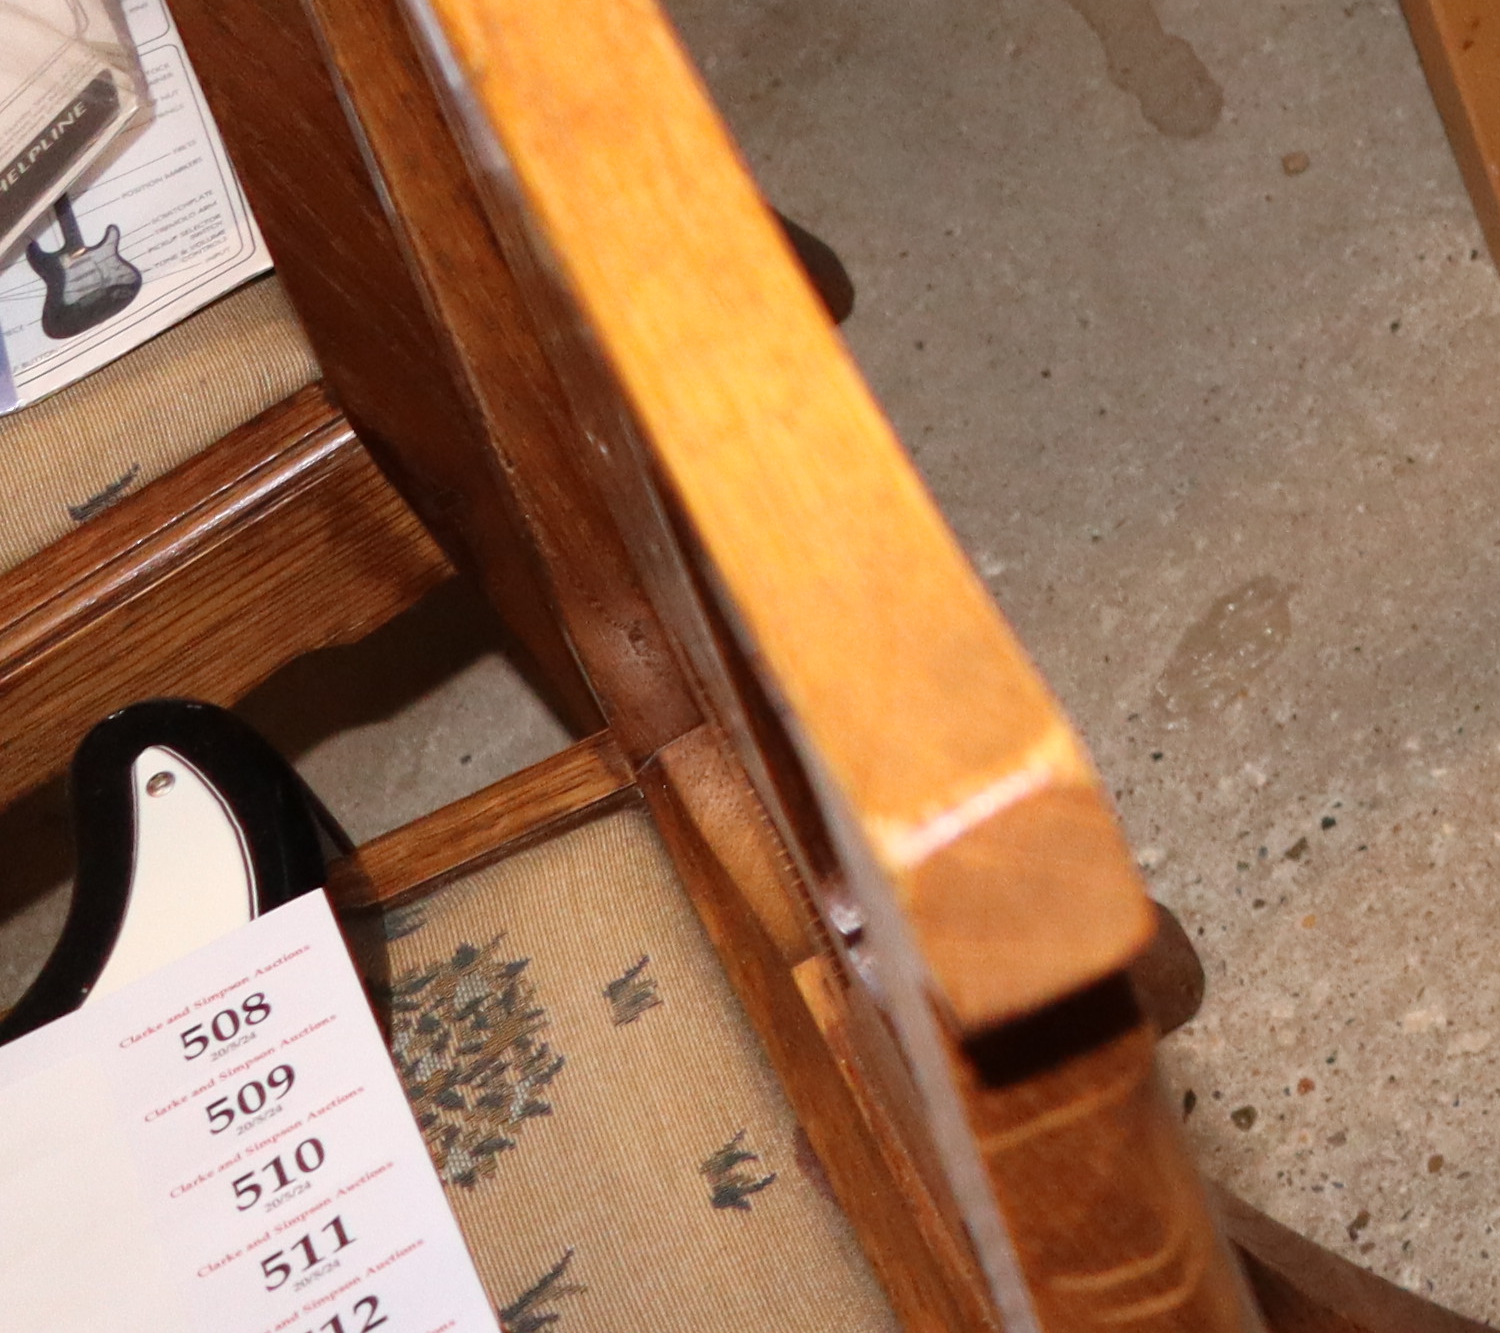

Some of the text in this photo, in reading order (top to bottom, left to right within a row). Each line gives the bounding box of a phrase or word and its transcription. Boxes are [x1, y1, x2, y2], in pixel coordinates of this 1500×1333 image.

[119, 944, 311, 1049] Clarke and Simpson Auctions
[180, 992, 272, 1061] 508
[144, 1014, 337, 1123] Clarke and Simpson Auctions
[205, 1063, 296, 1136] 509
[169, 1086, 365, 1199] Clarke and Simpson Auctions
[231, 1137, 326, 1212] 510
[196, 1161, 395, 1278] Clarke and Simpson Auctions
[260, 1214, 358, 1292] 511
[274, 1239, 425, 1331] and Simpson Auctions
[304, 1295, 388, 1333] 12
